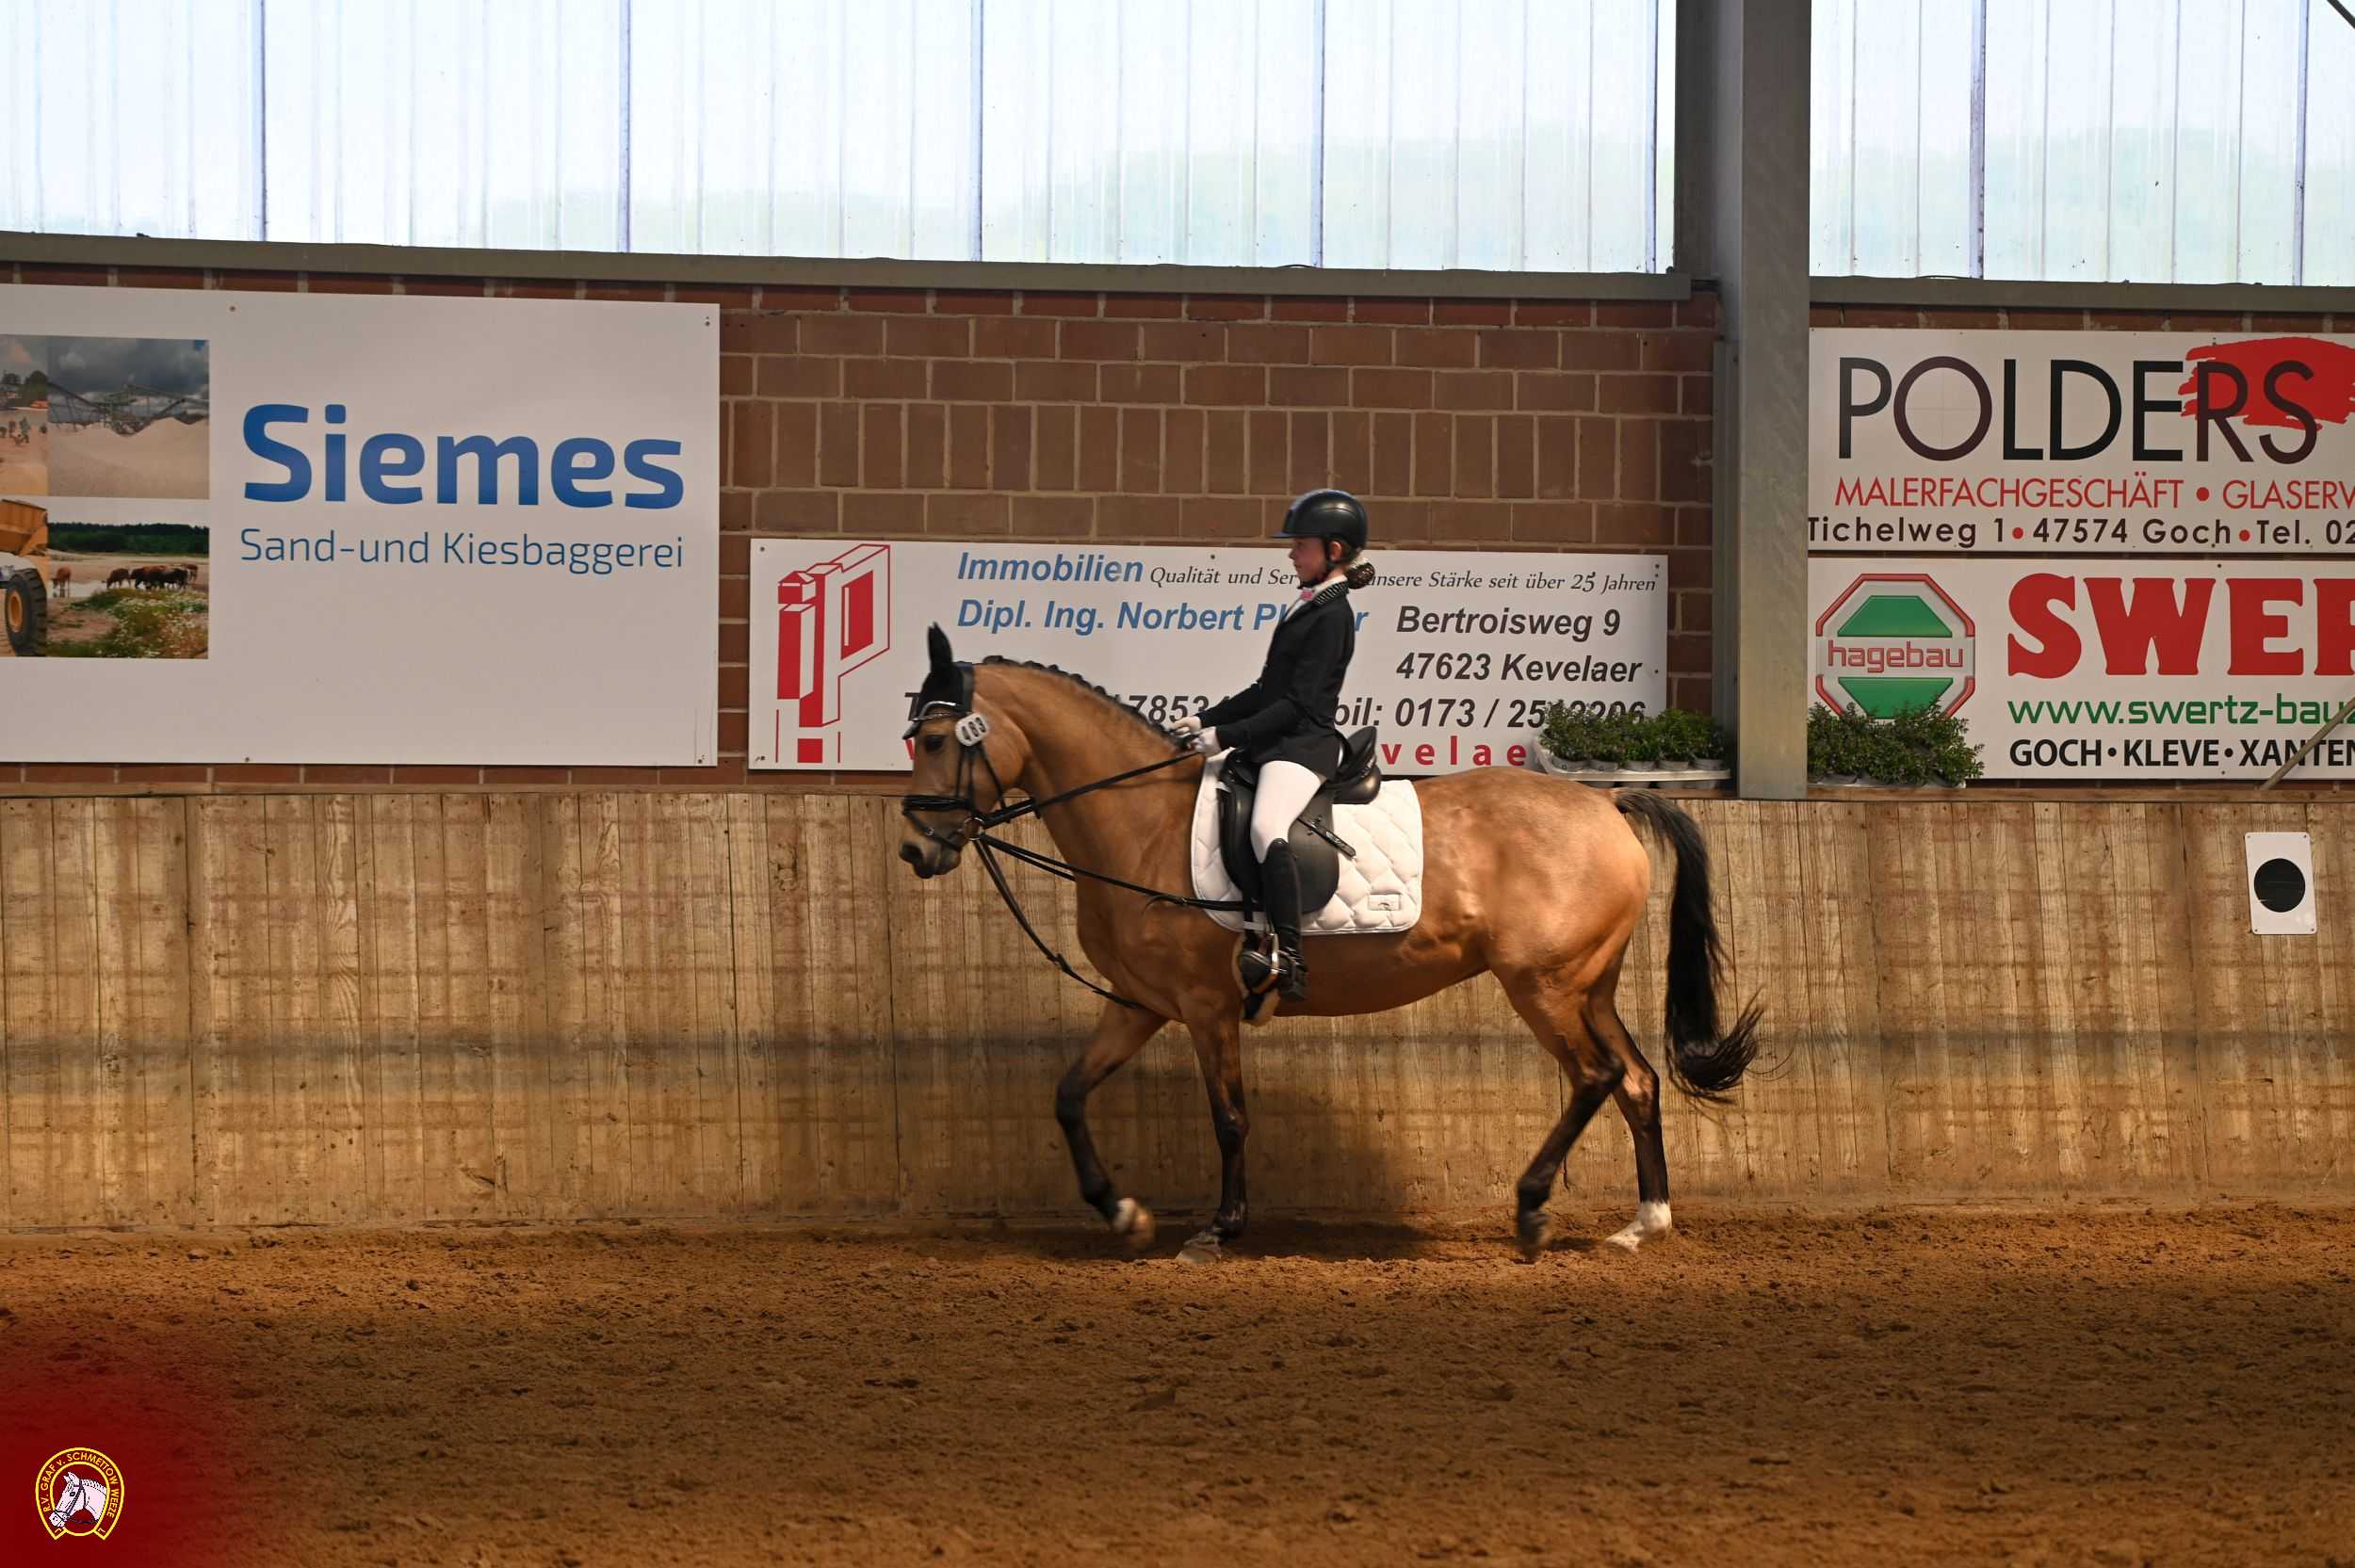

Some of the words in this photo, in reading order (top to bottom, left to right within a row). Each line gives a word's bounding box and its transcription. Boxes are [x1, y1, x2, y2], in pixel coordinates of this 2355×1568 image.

[1839, 356, 2318, 464] POLDERS
[243, 404, 685, 509] Siemes
[1834, 473, 2184, 509] MALERFACHGESCHÄFT
[1808, 516, 1977, 549] Tichelweg
[1993, 518, 2005, 542] 1
[2032, 518, 2129, 543] 47574
[2142, 518, 2232, 545] Goch
[2257, 520, 2311, 545] Tel.
[241, 527, 430, 564] Sand-und
[445, 531, 684, 575] Kiesbaggerei
[957, 552, 1145, 583] Immobilien
[1149, 566, 1221, 589] Qualität
[1227, 567, 1263, 585] und
[1428, 569, 1483, 589] Stärke
[1488, 572, 1519, 590] seit
[1526, 572, 1566, 590] über
[1570, 572, 1596, 592] 25
[1600, 573, 1656, 595] Jahren
[957, 599, 1032, 635] Dipl.
[1044, 600, 1104, 637] Ing.
[1117, 602, 1244, 631] Norbert
[1396, 606, 1593, 643] Bertroisweg
[1603, 608, 1620, 637] 9
[1396, 652, 1491, 681] 47623
[1502, 654, 1643, 683] Kevelaer
[1827, 640, 1964, 674] hagebau
[1395, 698, 1475, 728] 0173
[2007, 693, 2355, 725] www.swertz-bau
[2009, 739, 2103, 768] GOCH
[2124, 739, 2219, 767] KLEVE
